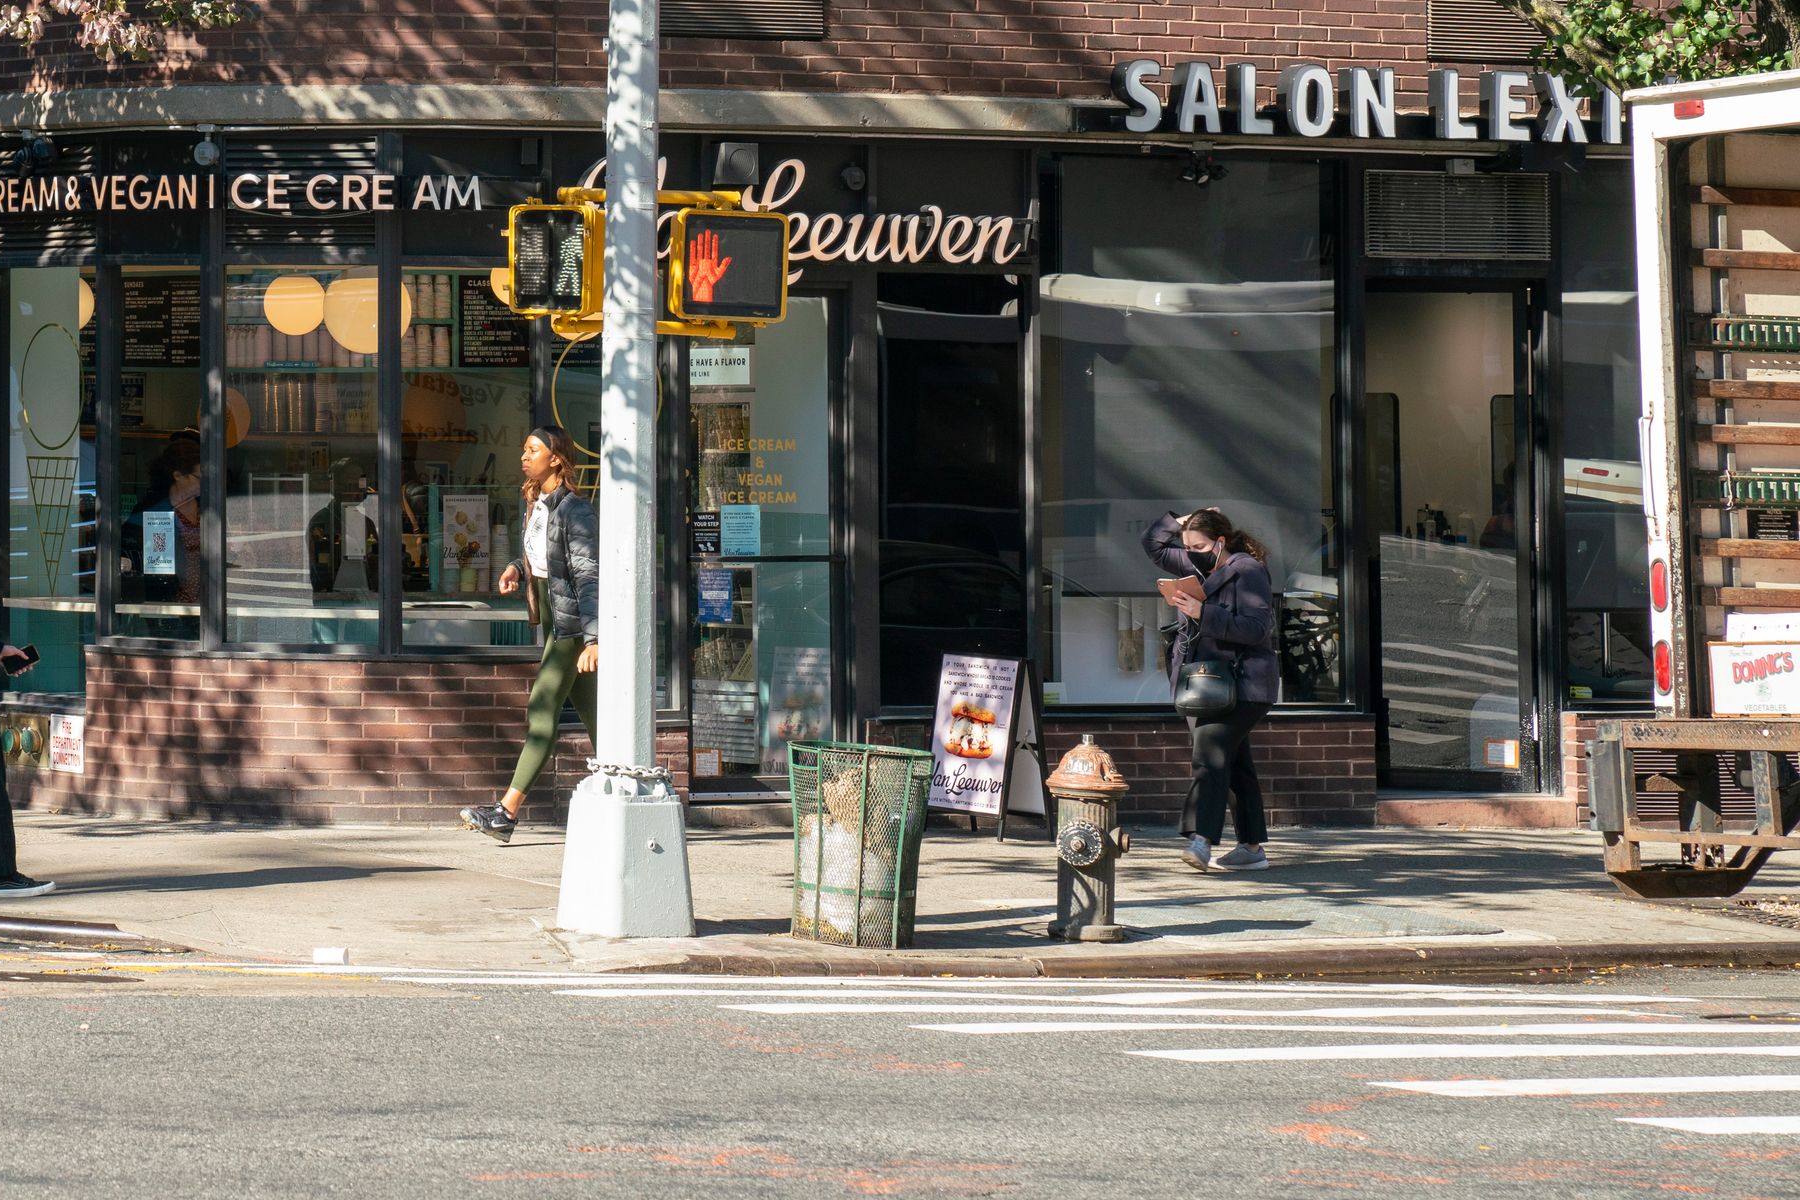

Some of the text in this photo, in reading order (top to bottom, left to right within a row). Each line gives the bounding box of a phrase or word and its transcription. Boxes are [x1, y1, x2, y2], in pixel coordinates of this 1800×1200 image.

[1111, 59, 1624, 143] SALON LEXI
[64, 176, 81, 211] &
[91, 175, 196, 210] VEGAN
[696, 358, 712, 366] HAVE
[715, 358, 719, 366] A
[721, 358, 746, 366] FLAVOR
[723, 439, 796, 450] ICE CREAM
[755, 457, 765, 468] &
[738, 473, 783, 486] VEGAN
[723, 491, 797, 503] ICE CREAM
[1732, 652, 1794, 684] DOMINIC'S
[62, 721, 72, 734] FIRE
[53, 735, 80, 751] DEPARTMENT
[53, 751, 80, 766] CONNECTION
